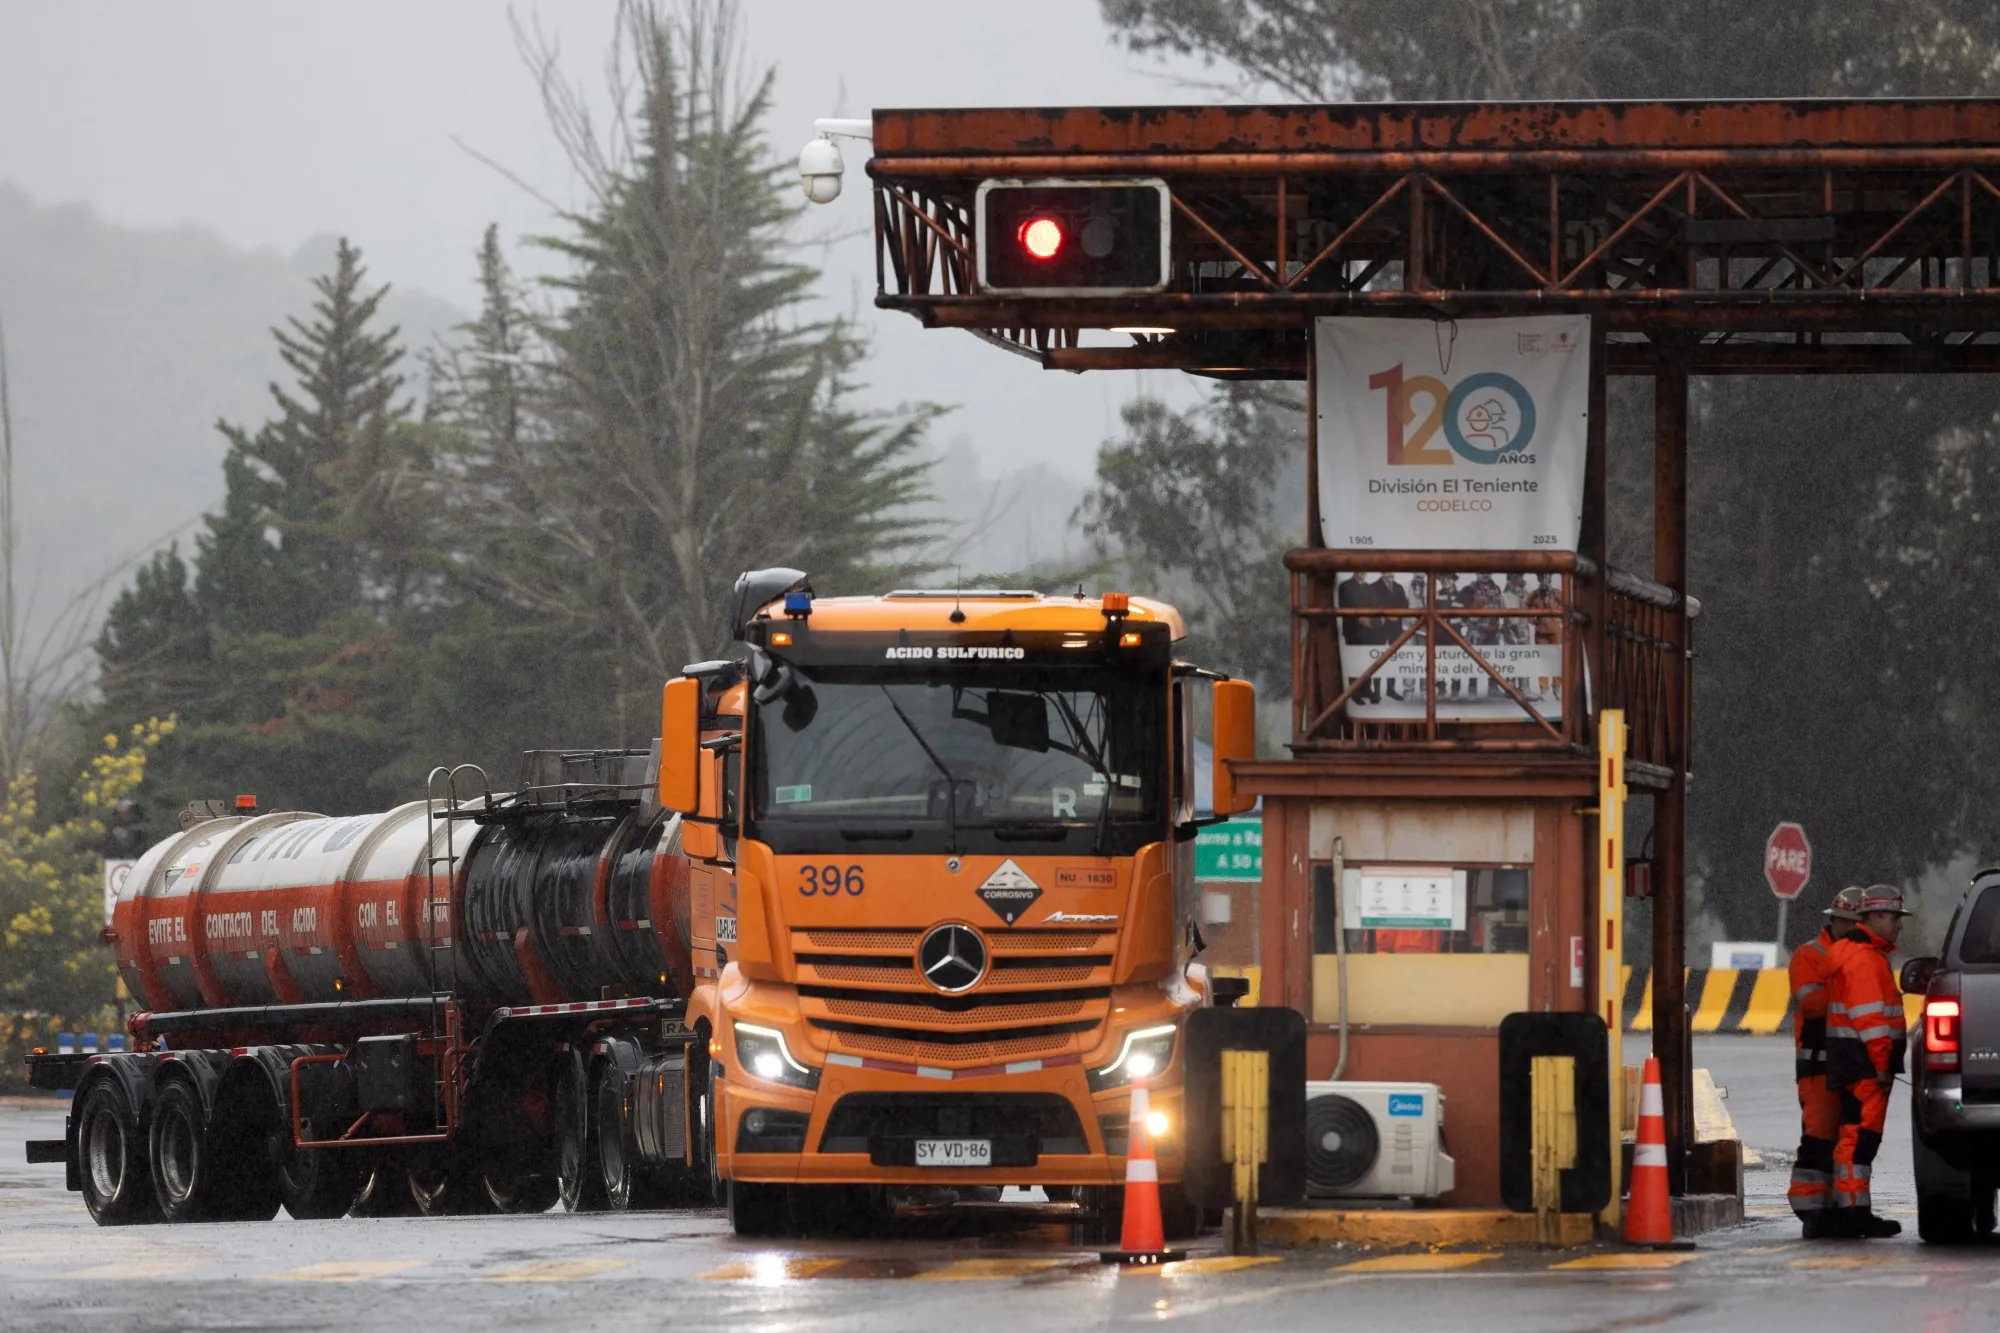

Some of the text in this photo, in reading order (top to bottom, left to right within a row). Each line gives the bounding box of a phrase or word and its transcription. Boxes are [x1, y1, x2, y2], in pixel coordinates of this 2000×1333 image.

[1369, 362, 1536, 465] 120
[1498, 452, 1537, 465] AÑOS
[1368, 477, 1539, 494] División El Teniente
[1416, 499, 1492, 512] CODELCO
[1349, 536, 1374, 545] 1905
[1532, 535, 1558, 545] 2025
[885, 646, 1026, 660] ACIDO SULFURICO
[1417, 651, 1425, 662] y
[1495, 648, 1505, 659] la
[1509, 650, 1540, 662] gran
[1452, 663, 1473, 674] del
[1476, 663, 1516, 674] cbre
[1767, 846, 1806, 874] PARE
[798, 864, 865, 897] 396
[1060, 873, 1077, 883] NU
[1087, 873, 1113, 884] 1830
[983, 890, 1034, 900] CORROSIVO
[148, 917, 172, 945] EVITE
[175, 916, 187, 942] EL
[206, 911, 252, 939] CONTACTO
[261, 909, 280, 936] DEL
[293, 906, 317, 932] ACIDO
[358, 902, 378, 929] CON
[386, 900, 399, 926] EL
